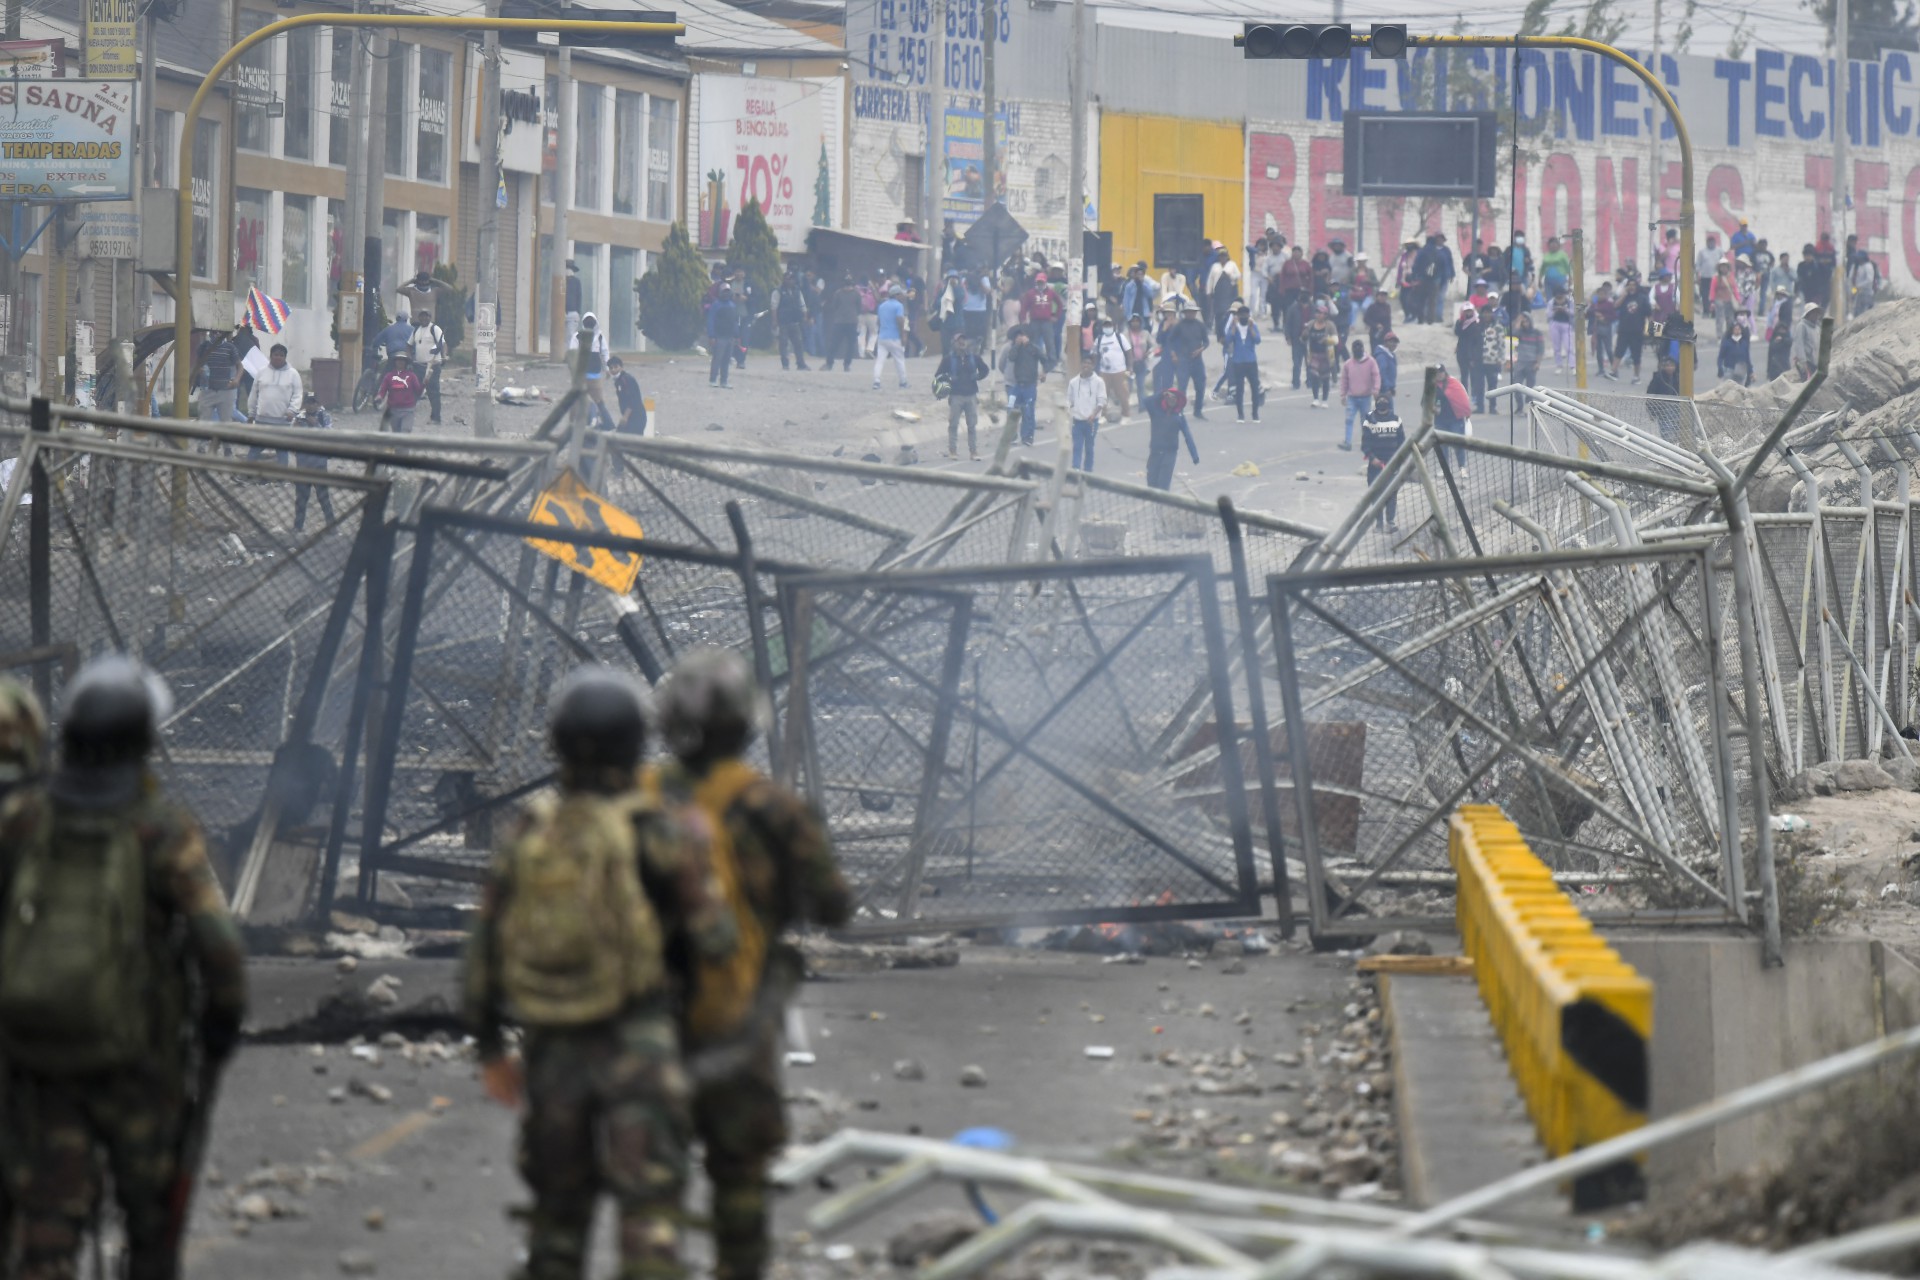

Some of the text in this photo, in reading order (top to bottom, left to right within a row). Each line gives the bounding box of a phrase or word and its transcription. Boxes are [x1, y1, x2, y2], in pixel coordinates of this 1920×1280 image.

[89, 0, 136, 22] VENTA LOTES
[100, 83, 110, 94] 2
[237, 64, 270, 92] OLCHONES
[94, 93, 126, 113] MIERCOLES
[419, 89, 446, 125] ÁBANAS
[745, 99, 777, 116] REGALA
[854, 85, 912, 123] CARRETERA
[1713, 48, 1920, 147] TECNIC
[26, 85, 118, 136] SAUNA
[736, 119, 768, 137] BUENOS
[2, 141, 122, 159] TEMPERADAS
[0, 161, 30, 170] NING,
[46, 172, 107, 181] EXTRAS
[735, 153, 793, 217] 70%
[0, 183, 55, 195] ERA
[192, 177, 211, 204] ZADAS
[1008, 187, 1028, 213] CAS
[90, 240, 132, 256] 959319716
